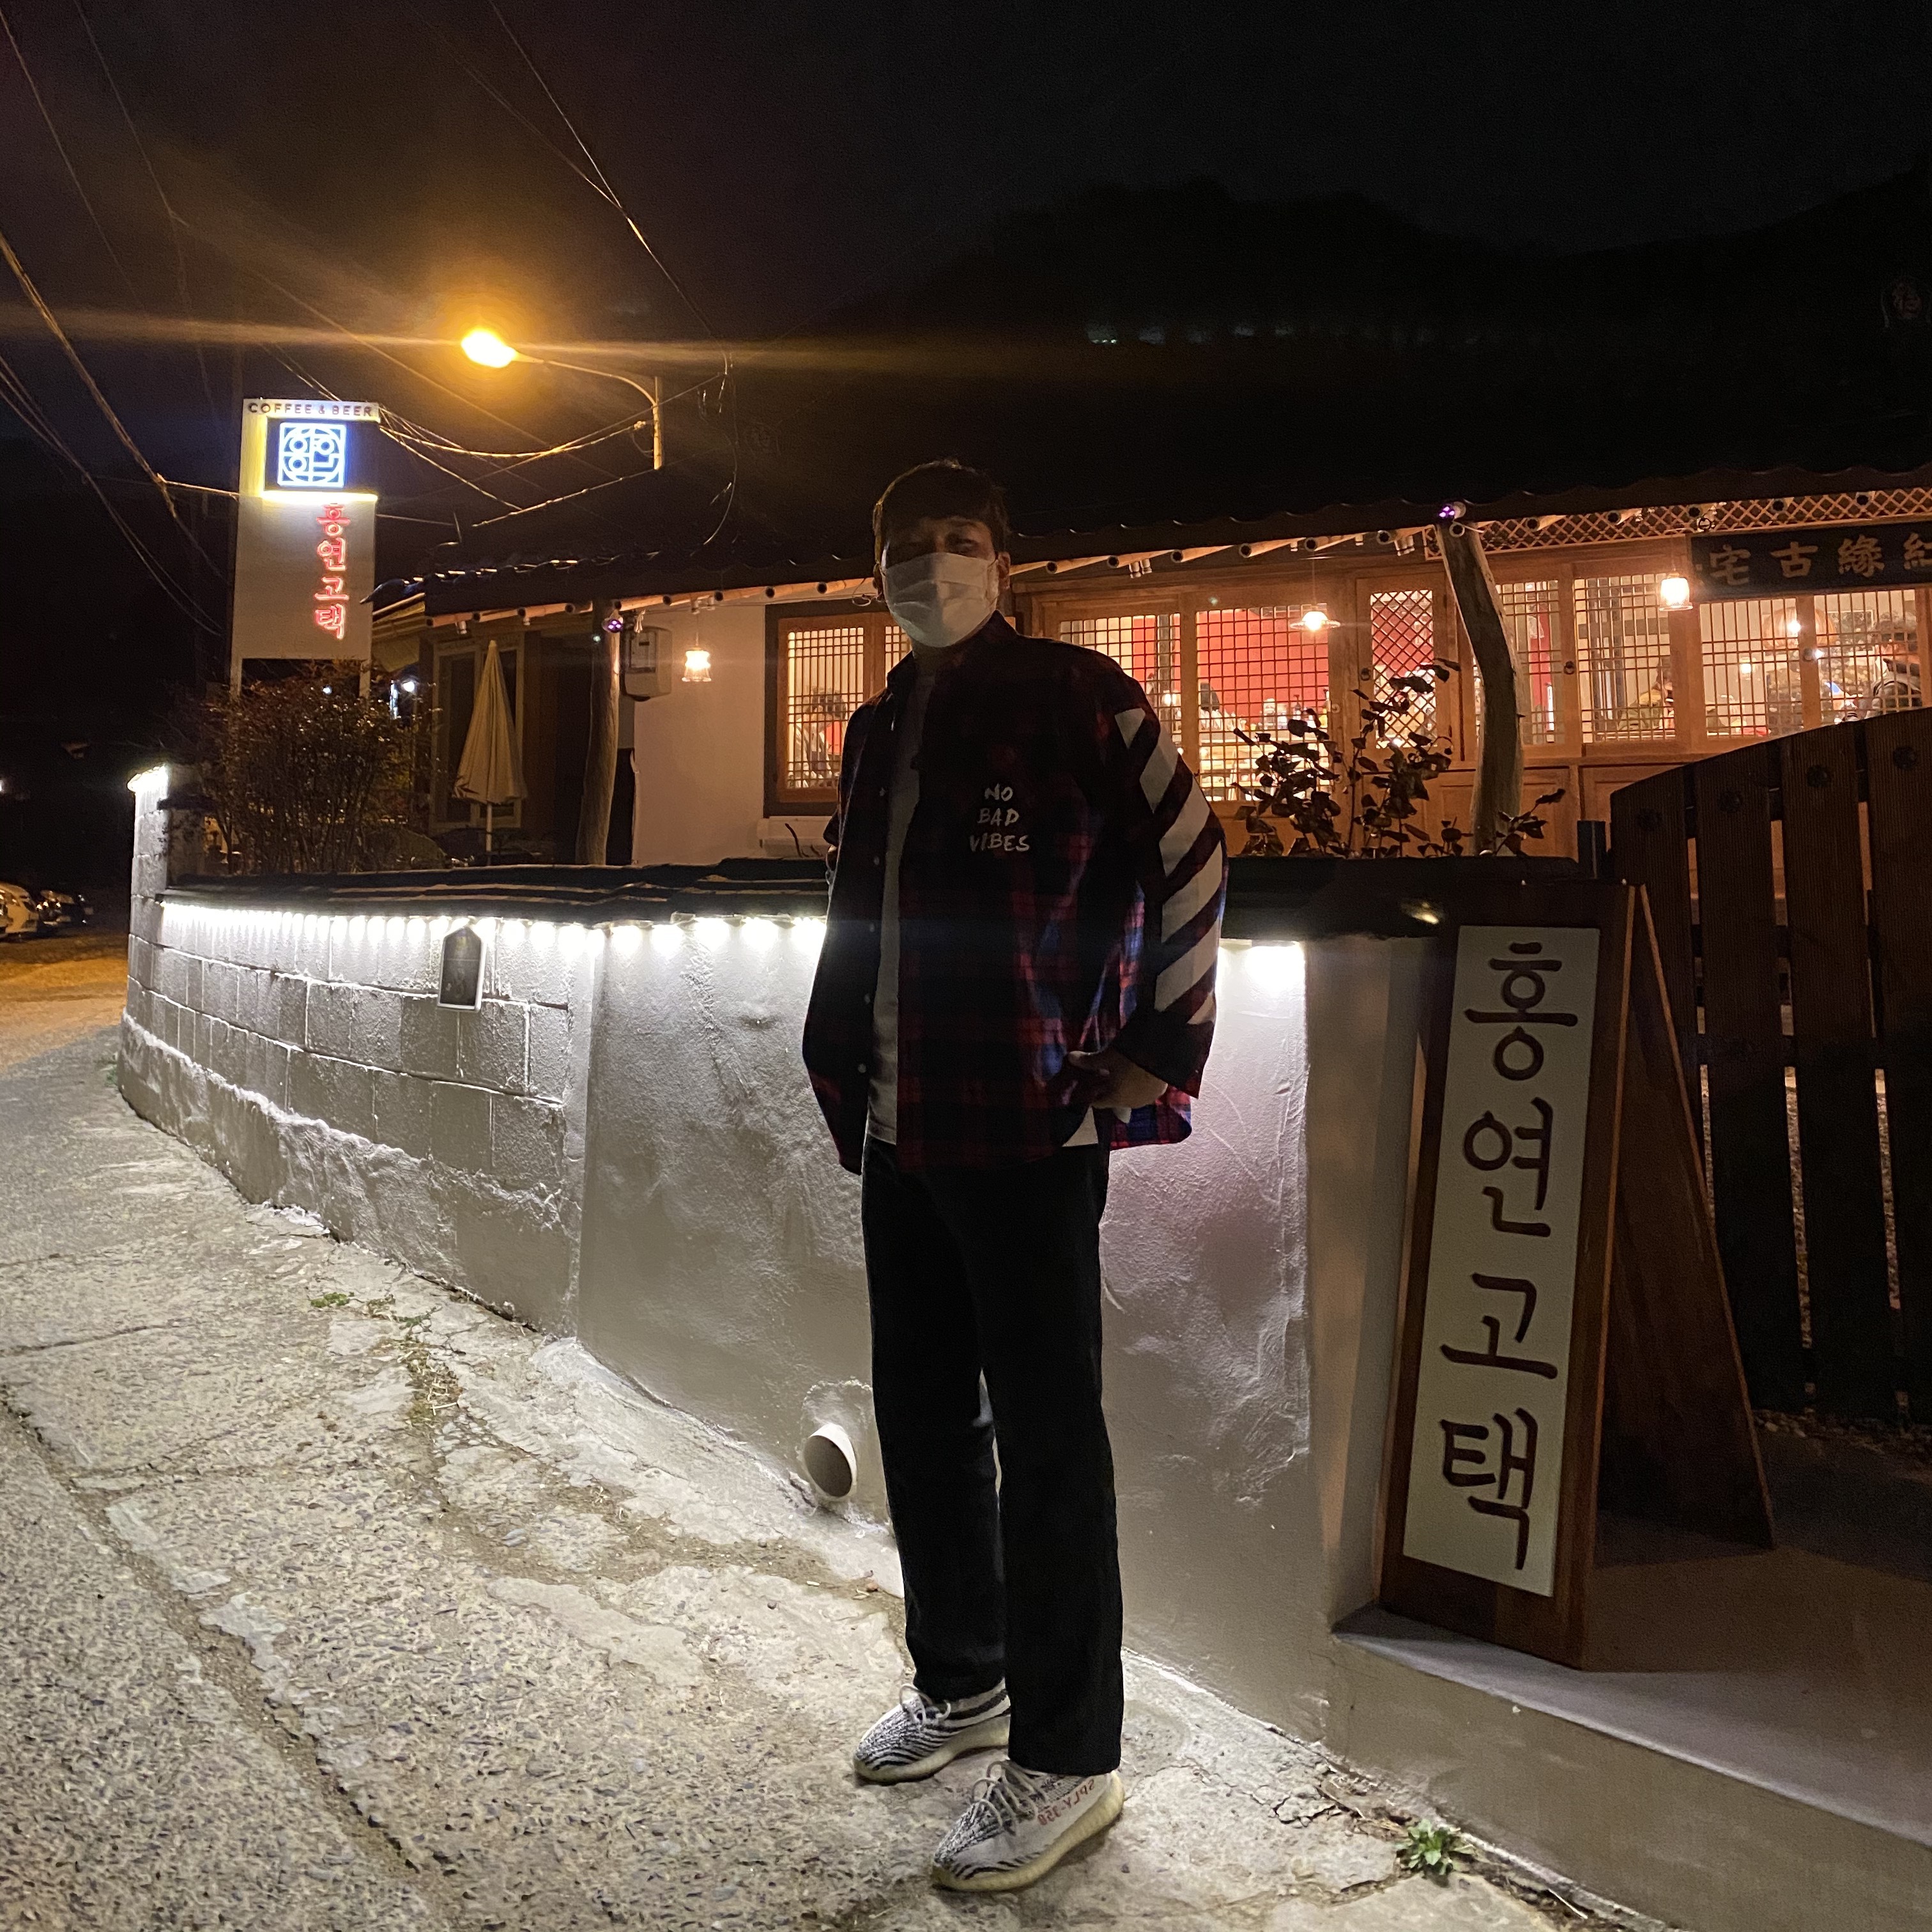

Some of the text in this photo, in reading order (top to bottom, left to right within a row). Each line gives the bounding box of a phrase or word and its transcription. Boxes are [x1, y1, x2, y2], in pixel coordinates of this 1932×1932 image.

[248, 402, 372, 417] COFFEE & BEER
[314, 503, 351, 640] 홍연고택
[984, 783, 1013, 802] NO
[977, 808, 1020, 827] BAD
[969, 832, 1030, 852] VIBES
[1440, 942, 1578, 1570] 홍연고택
